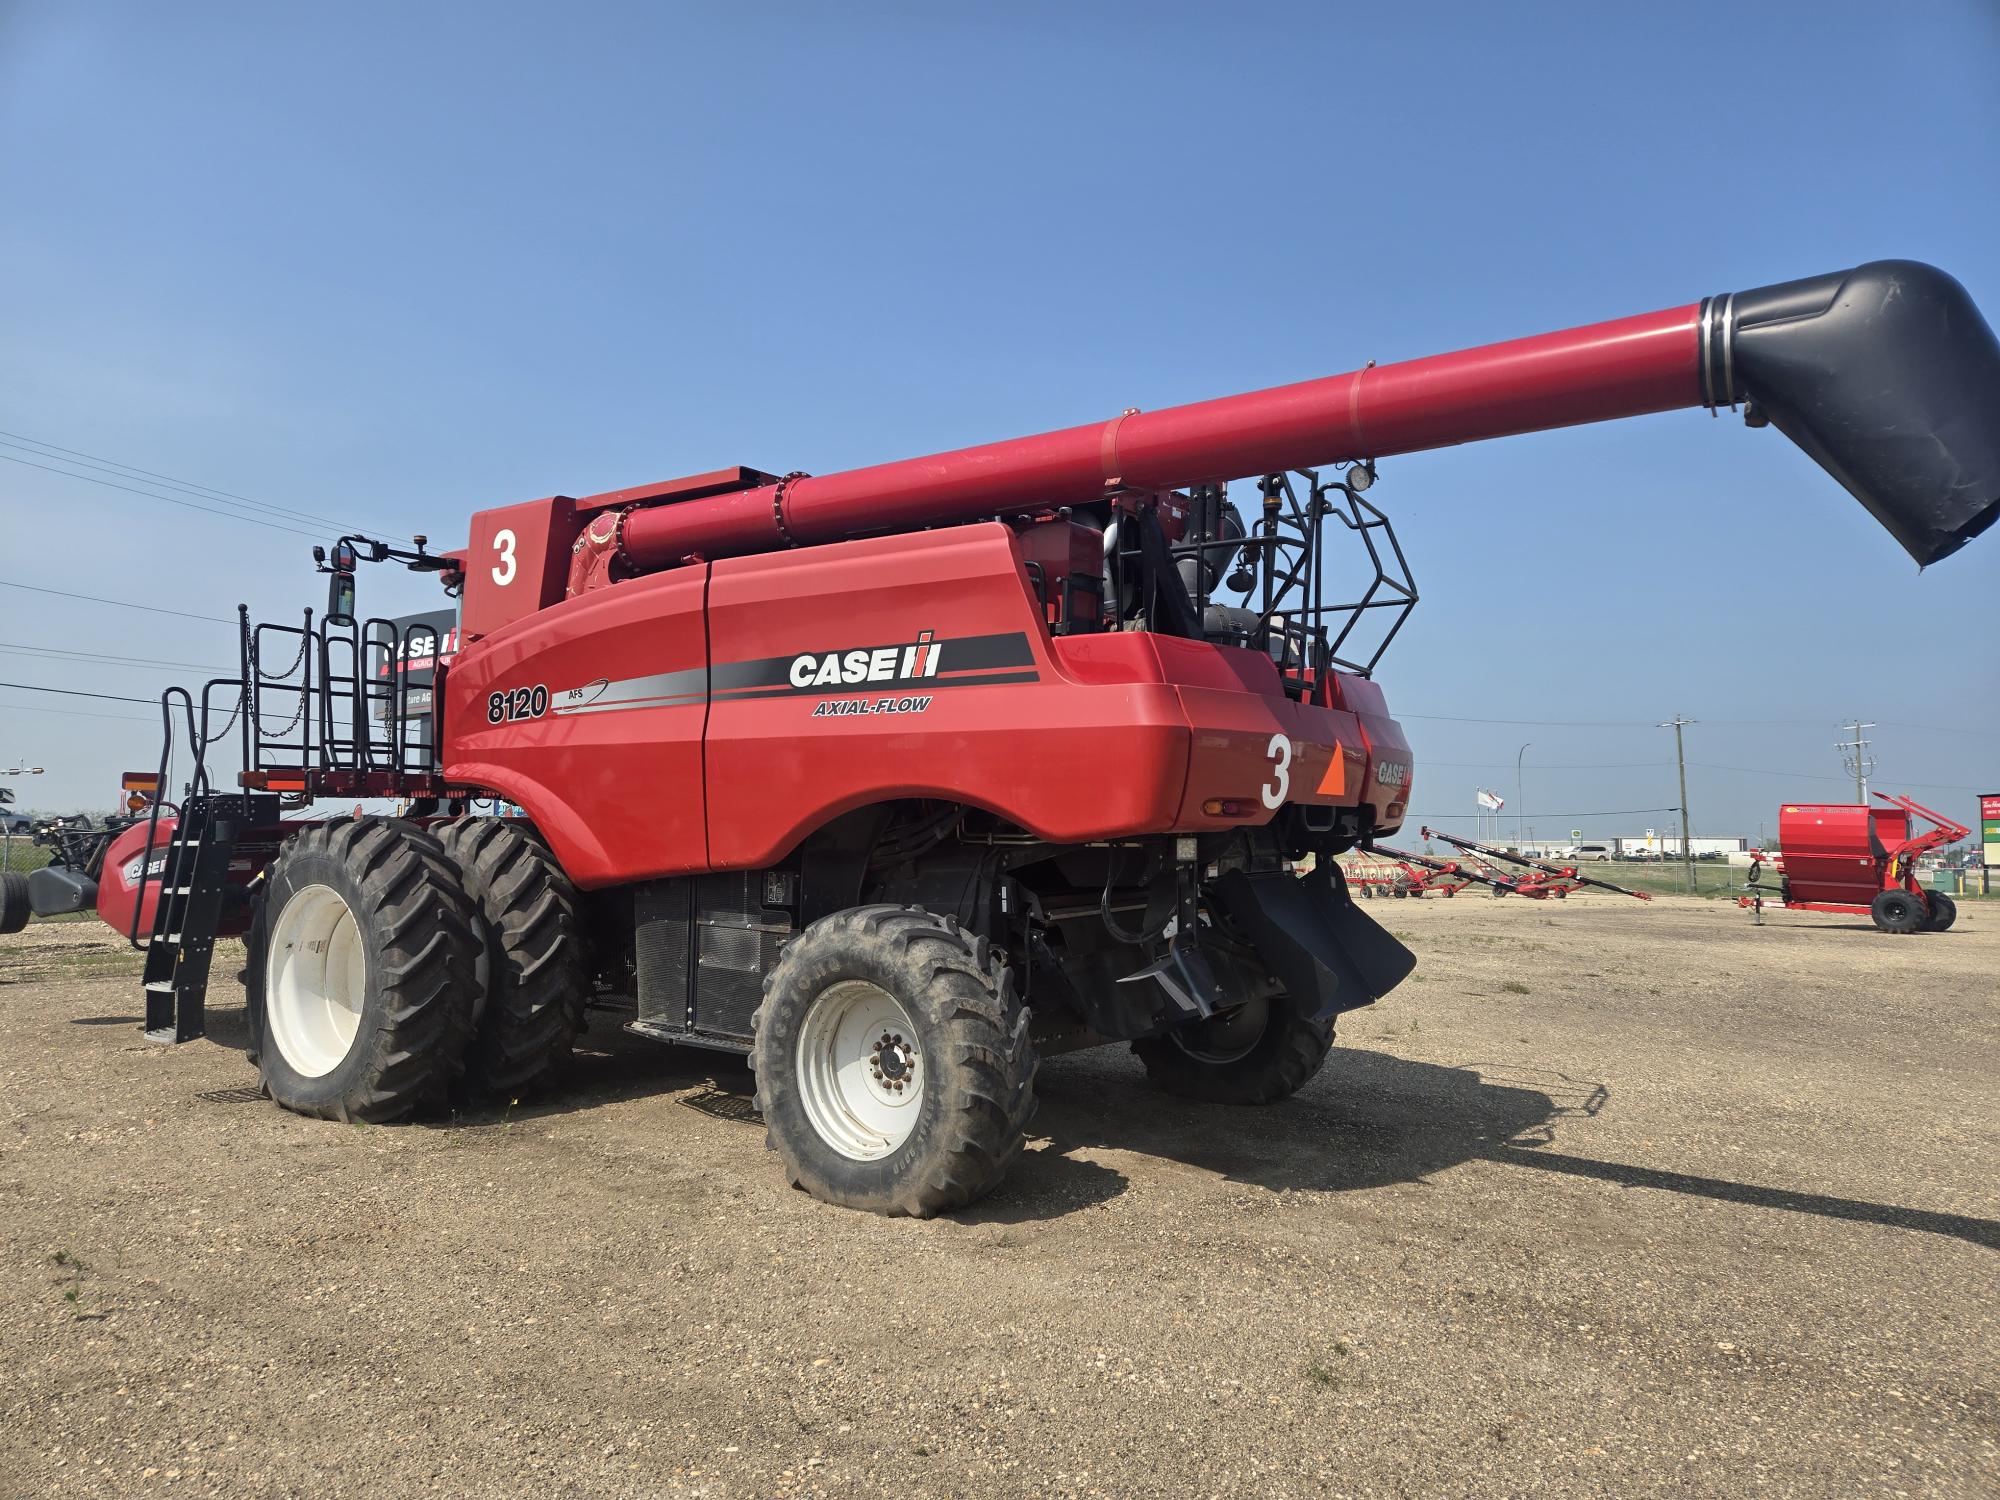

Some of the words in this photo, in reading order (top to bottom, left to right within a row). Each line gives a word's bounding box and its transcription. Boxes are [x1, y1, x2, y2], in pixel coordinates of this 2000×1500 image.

[492, 528, 517, 586] 3
[789, 647, 899, 688] CASE
[488, 684, 549, 724] 8120
[568, 689, 583, 699] AFS
[812, 696, 933, 717] AXIAL-FLOW
[1262, 733, 1291, 810] 3
[1379, 761, 1403, 784] CASE
